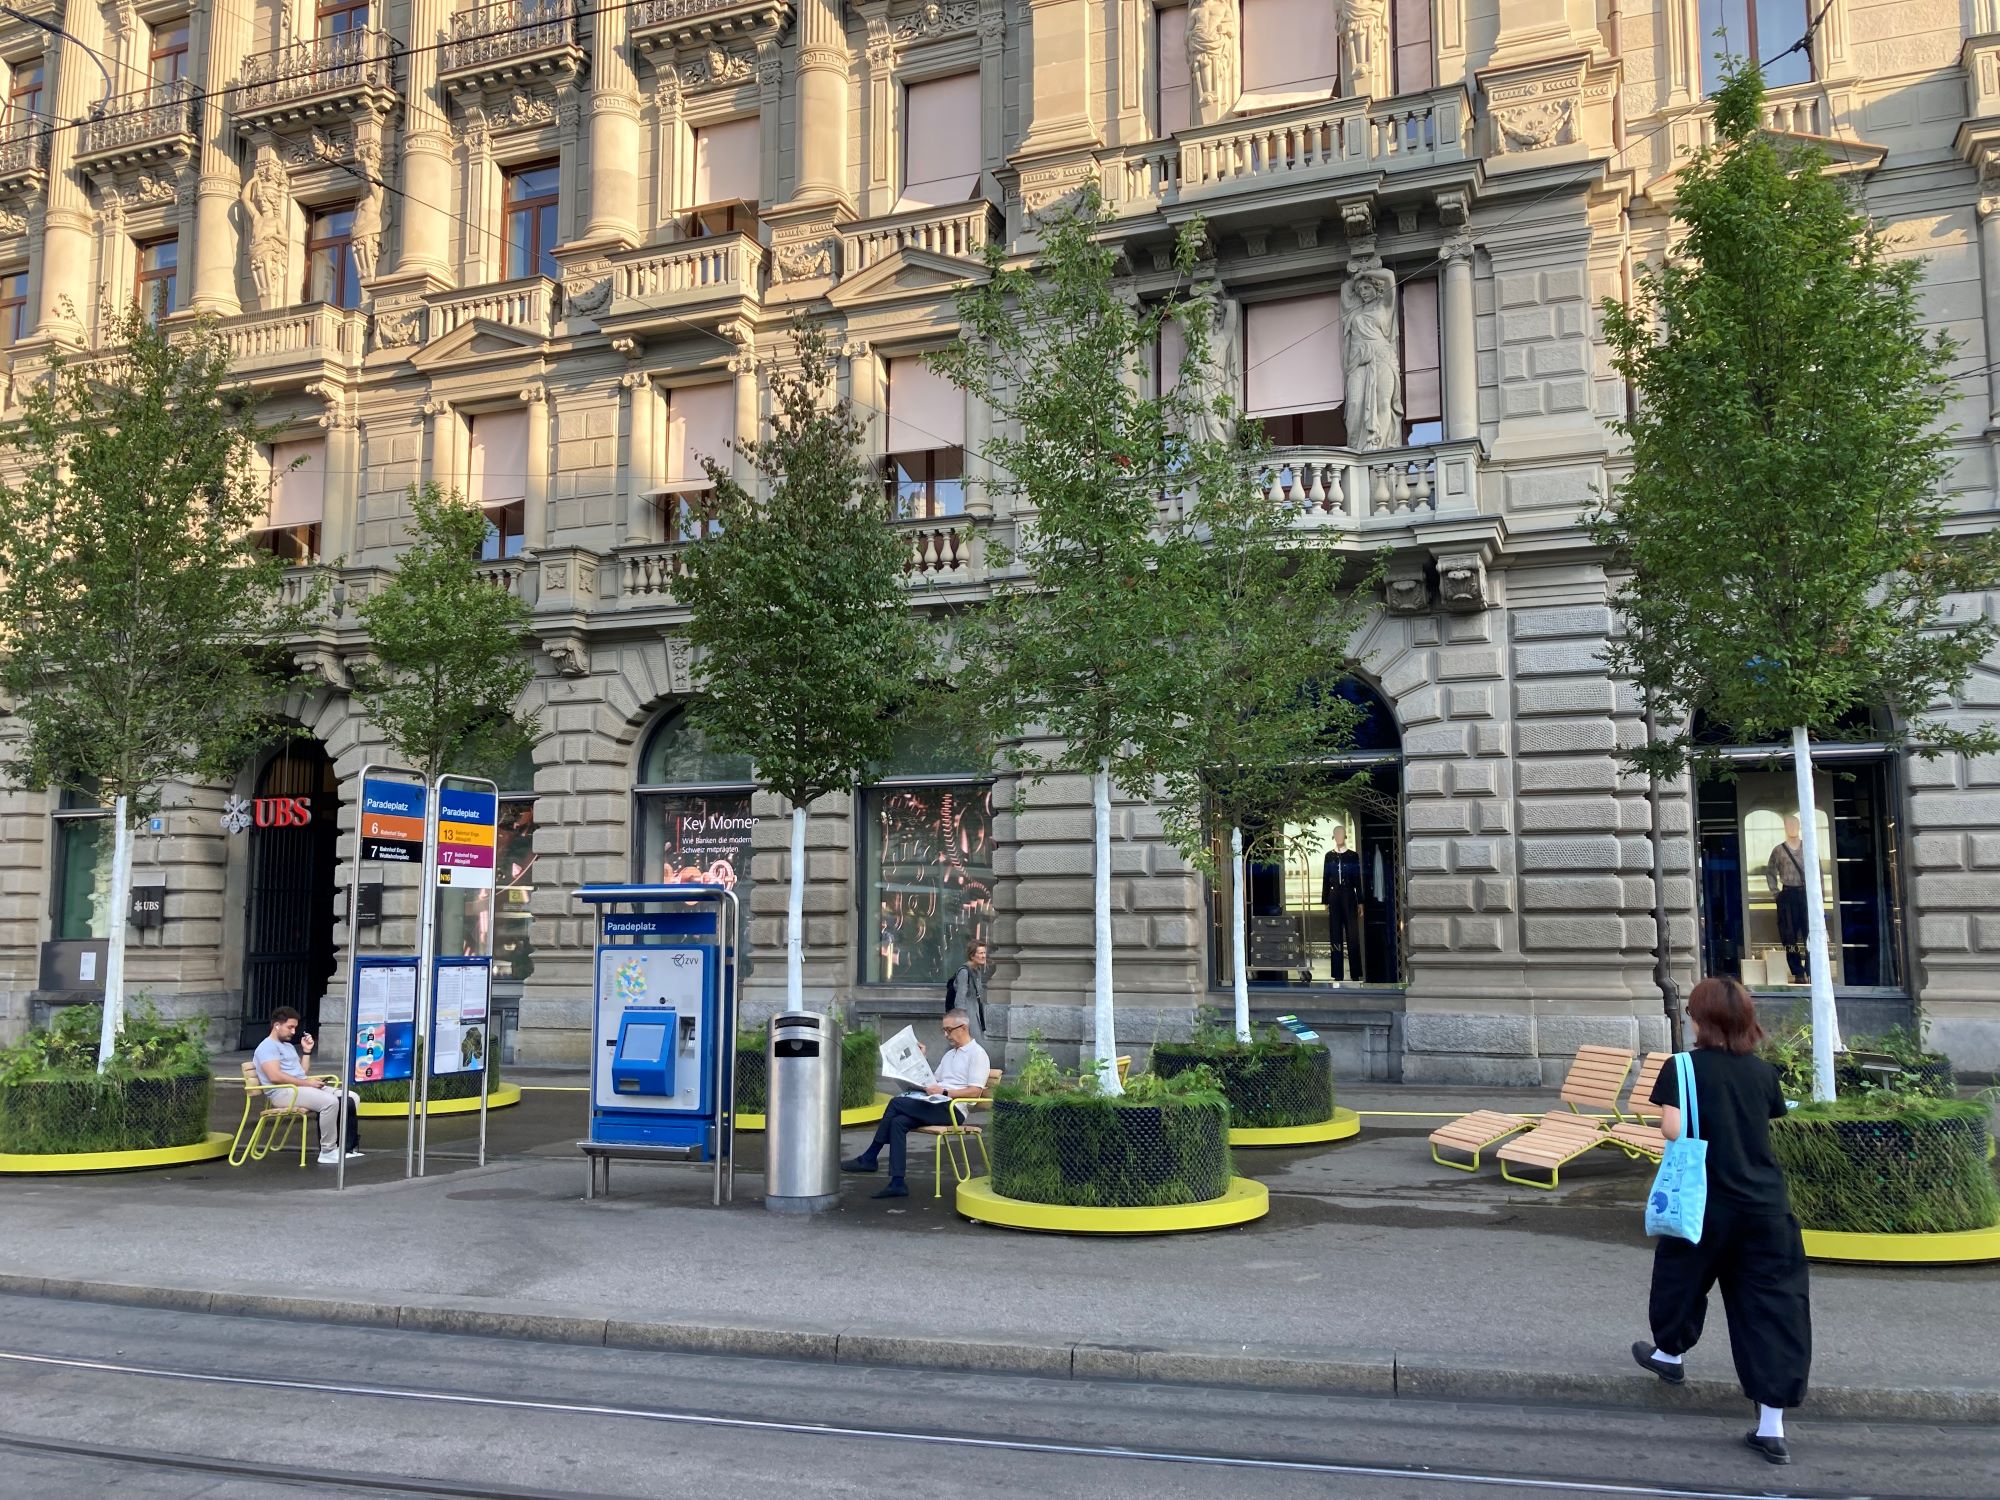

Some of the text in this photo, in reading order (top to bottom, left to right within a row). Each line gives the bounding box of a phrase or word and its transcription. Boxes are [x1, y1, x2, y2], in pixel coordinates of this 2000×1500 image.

[367, 798, 409, 811] Paradeplatz
[255, 797, 312, 827] UBS
[442, 806, 480, 819] Paradeplatz
[371, 822, 379, 834] 6
[683, 816, 707, 833] Key
[444, 829, 454, 841] 13
[682, 837, 694, 845] Wie
[695, 836, 717, 844] Banken
[718, 836, 728, 844] die
[371, 845, 378, 858] 7
[682, 846, 705, 854] Schweiz
[443, 851, 454, 863] 17
[143, 901, 160, 911] UBS
[607, 922, 656, 932] Paradeplatz
[685, 957, 699, 965] ZVV
